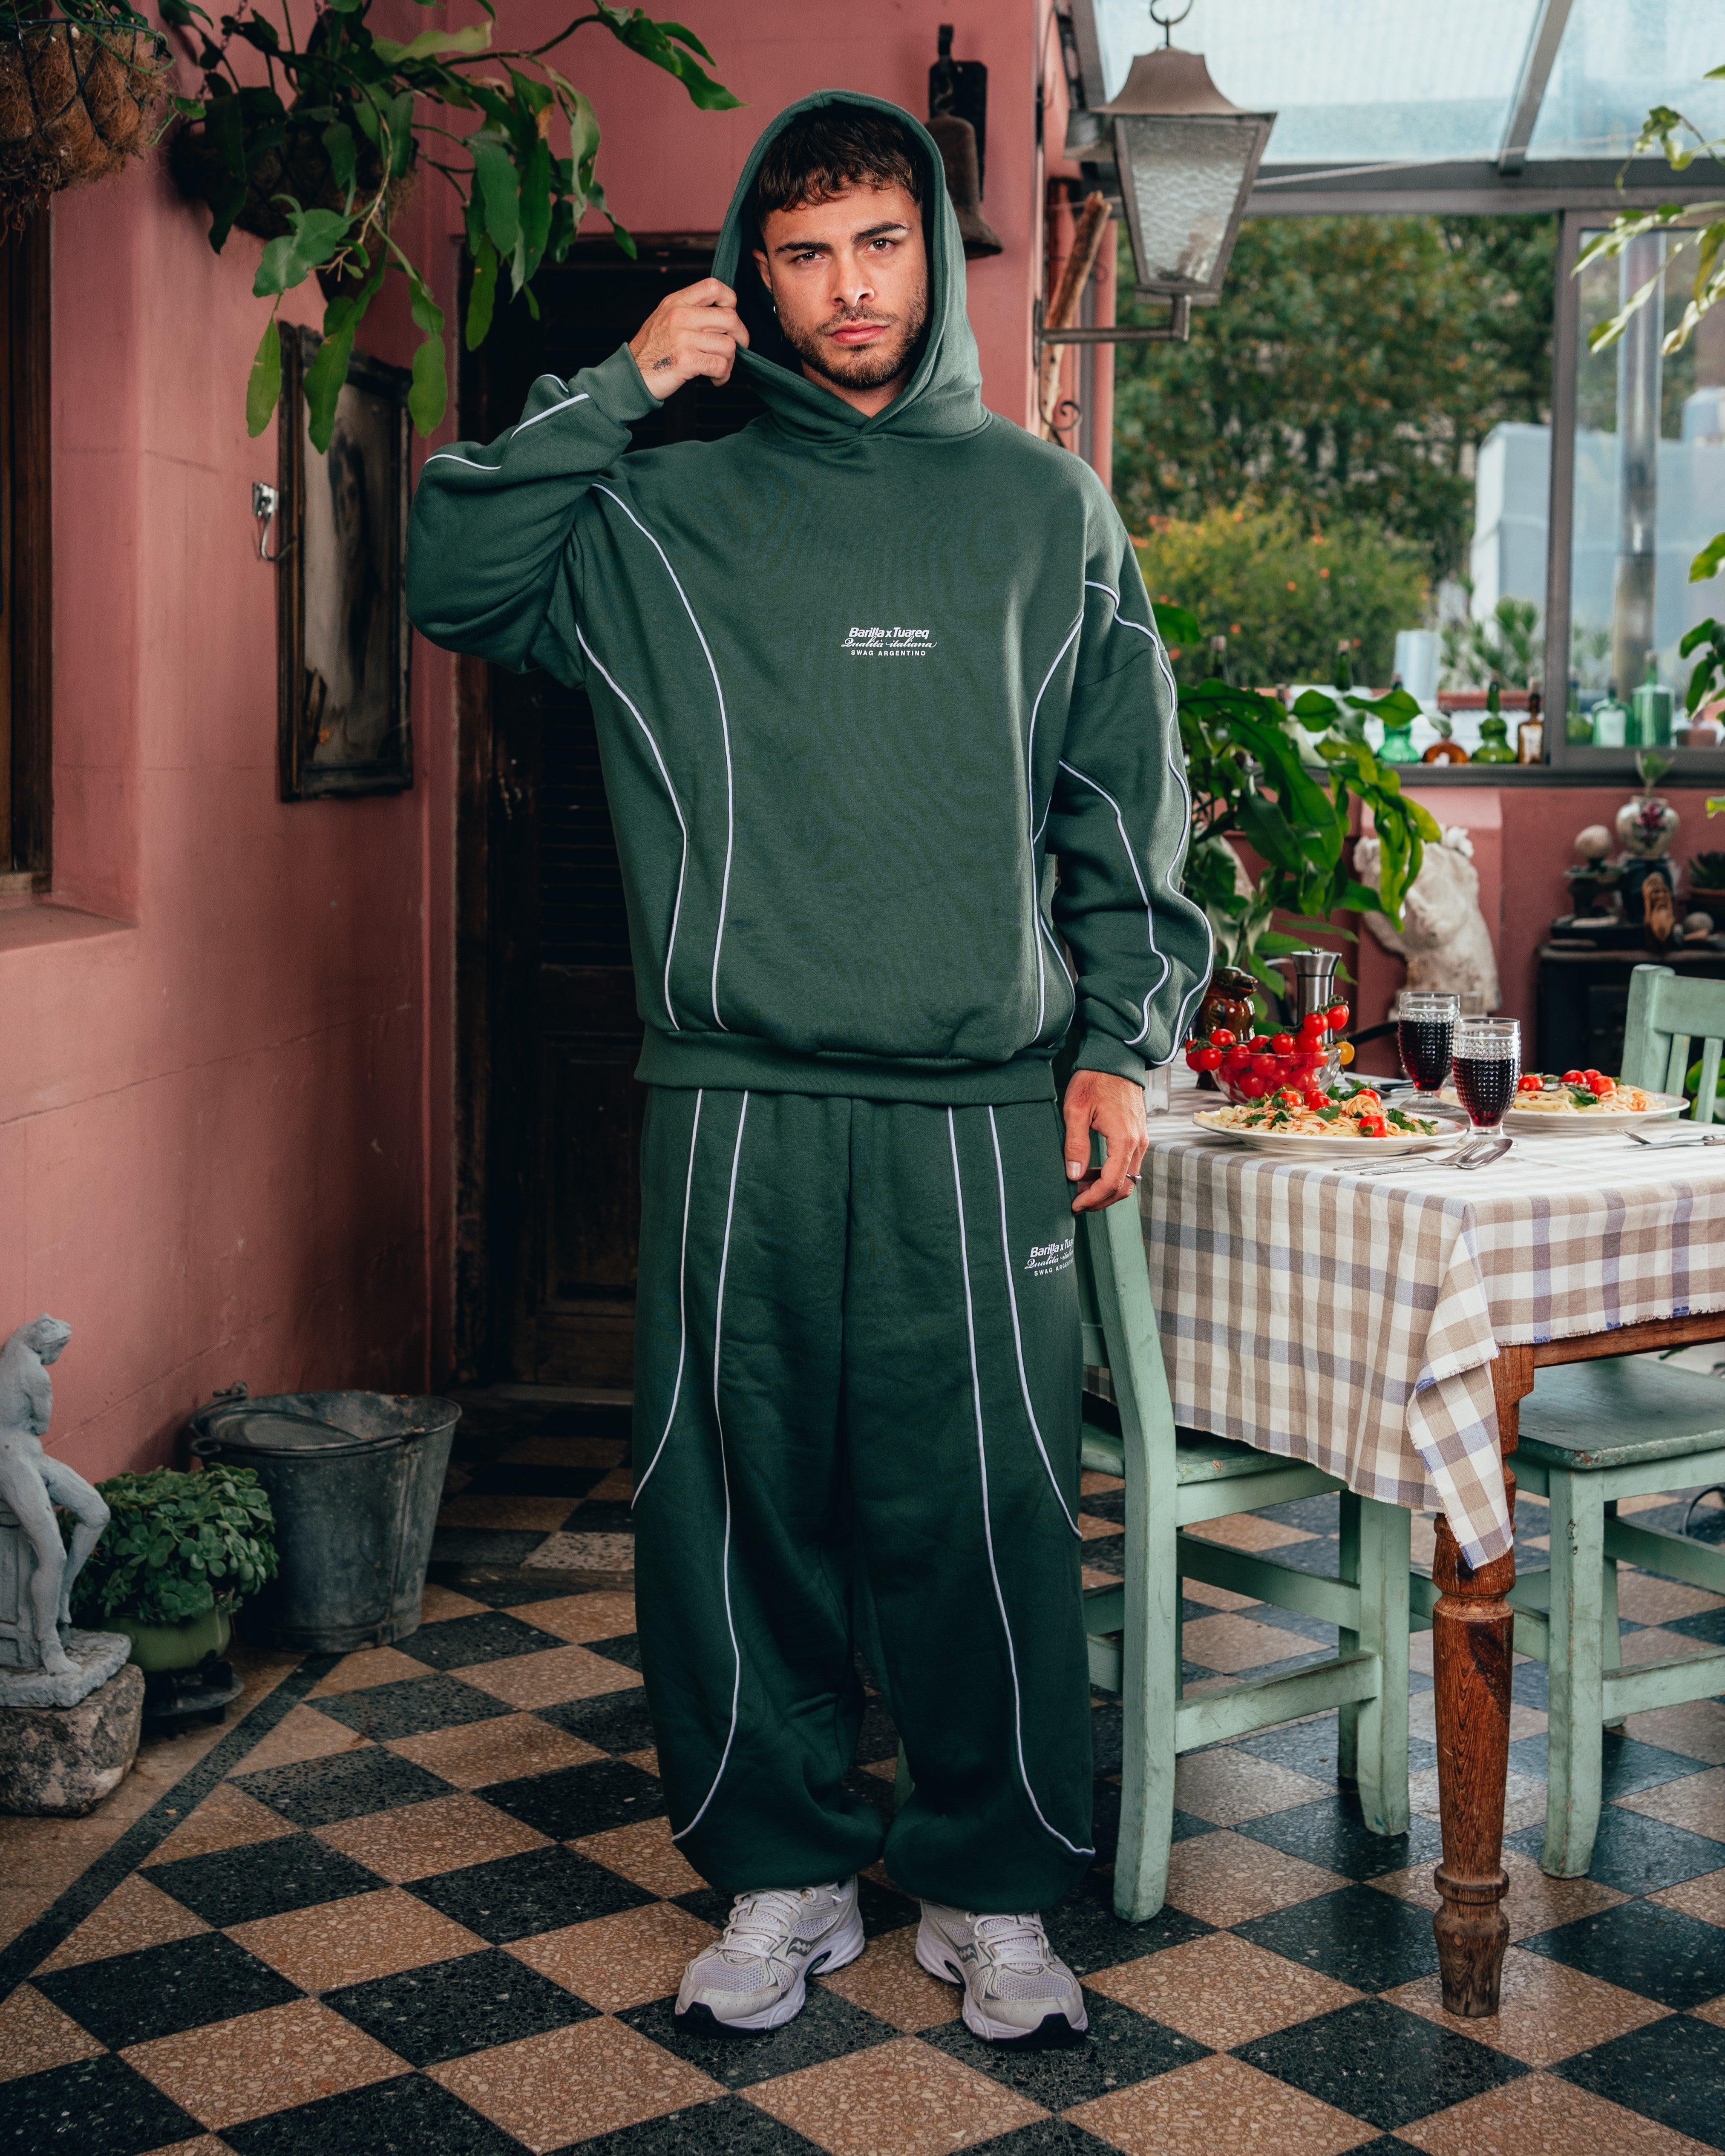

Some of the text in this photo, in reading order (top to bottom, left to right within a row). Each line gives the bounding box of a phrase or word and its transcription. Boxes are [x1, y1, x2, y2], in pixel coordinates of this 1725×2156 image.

[849, 627, 885, 637] Barilla
[893, 627, 930, 639] Tuareq
[841, 635, 937, 648] Qualità italiana
[1030, 1243, 1059, 1257] Barilla
[1034, 1268, 1052, 1276] SWAG
